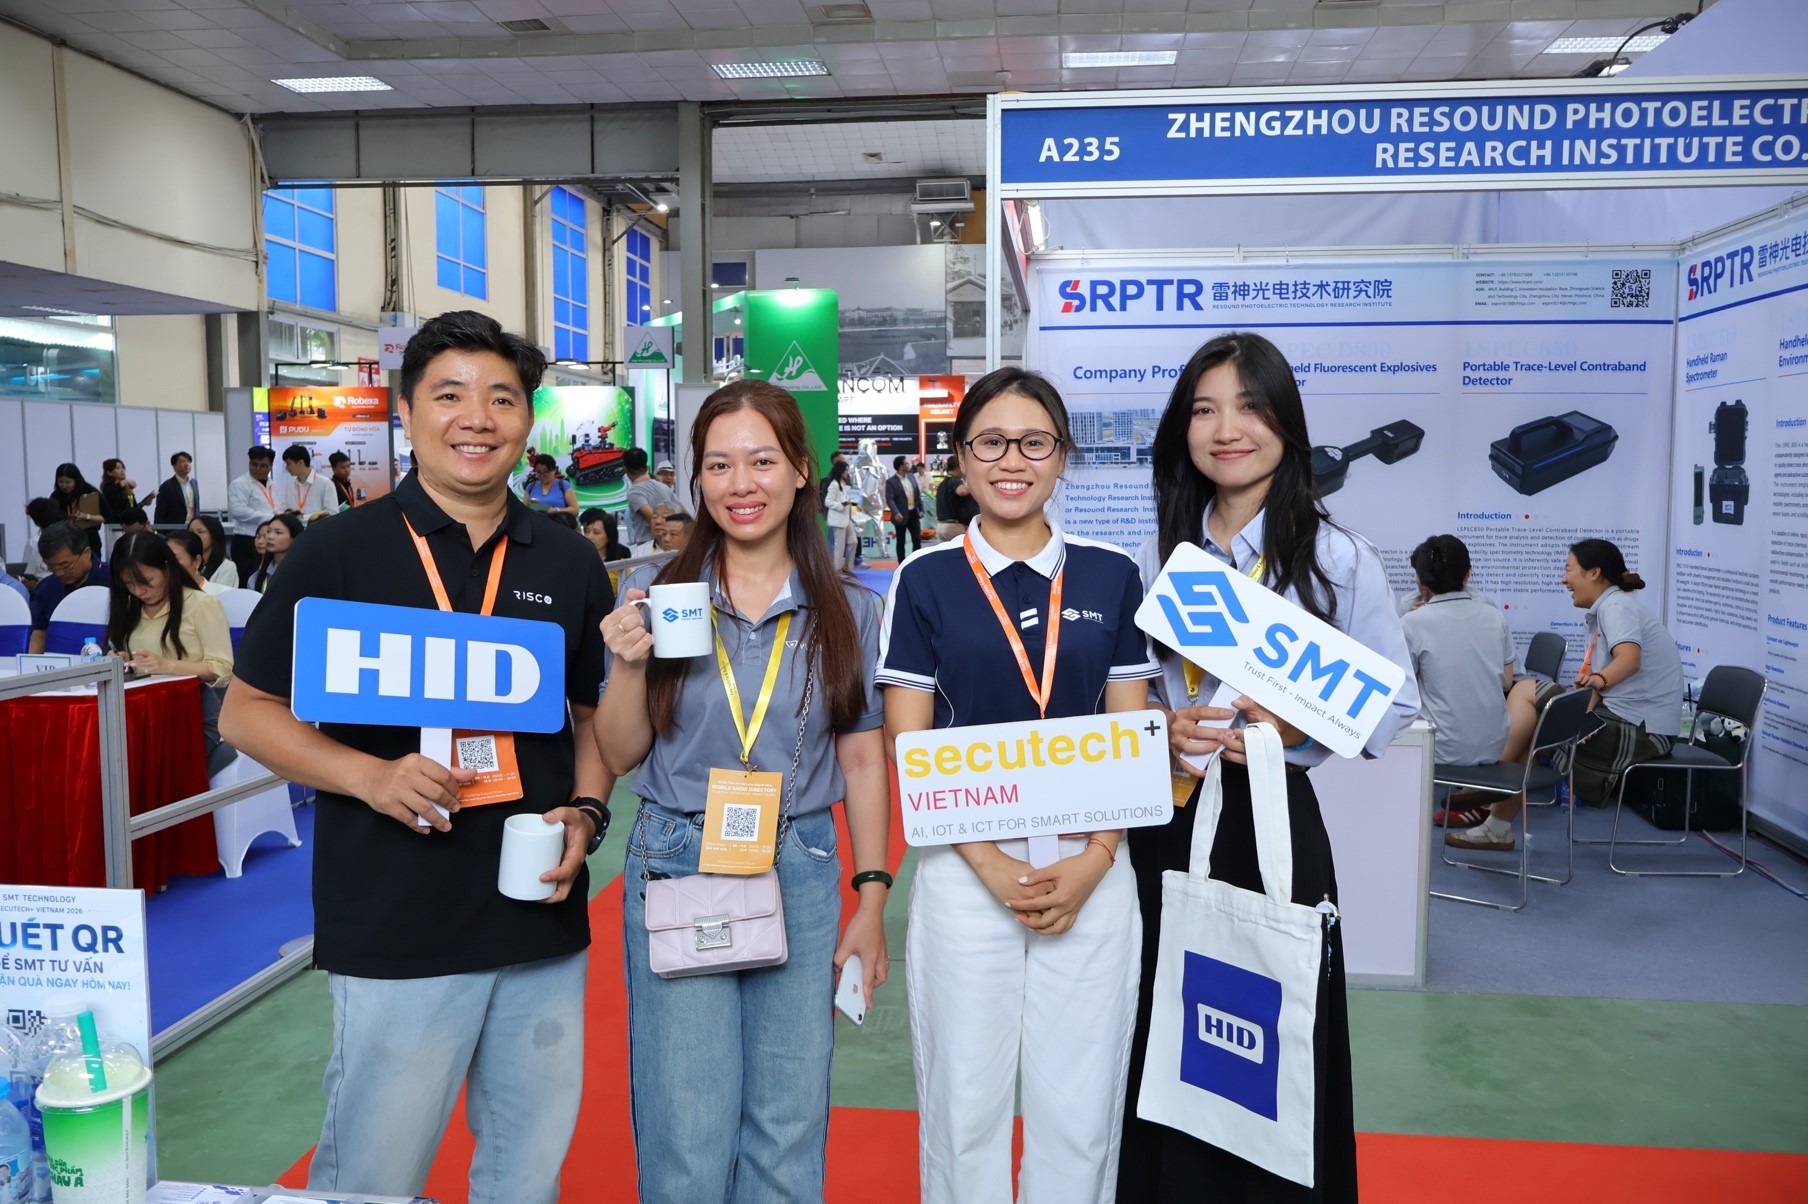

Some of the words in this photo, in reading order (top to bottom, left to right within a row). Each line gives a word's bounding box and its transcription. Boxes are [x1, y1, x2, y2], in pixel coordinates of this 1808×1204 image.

[1166, 108, 1380, 138] ZHENGZHOU
[1390, 104, 1557, 133] RESOUND
[1039, 137, 1121, 162] A235
[1375, 139, 1551, 168] RESEARCH
[1562, 135, 1743, 165] INSTITUTE
[1687, 245, 1754, 301] SRPTR
[1058, 278, 1204, 313] SRPTR
[1212, 279, 1392, 301] 雷神光电技术研究院
[1463, 361, 1510, 372] Portable
[1513, 361, 1577, 372] Trace-Level
[1580, 361, 1647, 372] Contraband
[1709, 351, 1728, 364] Raman
[1073, 365, 1147, 382] Company
[1151, 364, 1186, 380] Prof
[1314, 362, 1377, 373] Fluorescent
[1380, 362, 1438, 375] Explosives
[839, 376, 905, 394] NCOM
[1462, 375, 1513, 386] Detector
[347, 396, 379, 405] Robexa
[288, 425, 310, 433] PUDU
[1065, 494, 1106, 503] Technology
[1095, 518, 1111, 526] type
[1457, 511, 1512, 520] Introduction
[682, 608, 703, 617] SMT
[1082, 610, 1103, 621] SMT
[325, 627, 541, 704] HID
[1252, 622, 1392, 720] SMT
[1243, 661, 1265, 680] Trust
[1266, 676, 1287, 694] First
[1294, 693, 1327, 718] Impact
[1328, 715, 1361, 739] Always
[908, 784, 1019, 812] VIETNAM
[911, 826, 928, 839] AI,
[932, 824, 954, 837] IOT
[958, 823, 967, 834] &
[972, 821, 994, 833] ICT
[998, 818, 1027, 831] FOR
[1031, 813, 1080, 828] SMART
[1084, 805, 1163, 823] SOLUTIONS
[22, 895, 76, 903] TECHNOLOGY
[0, 916, 64, 951] UÉT
[71, 923, 125, 954] QR
[14, 958, 45, 971] SMT
[49, 959, 69, 972] TƯ
[73, 957, 103, 973] VẤN
[46, 977, 78, 988] NGAY
[1204, 1013, 1257, 1050] HID
